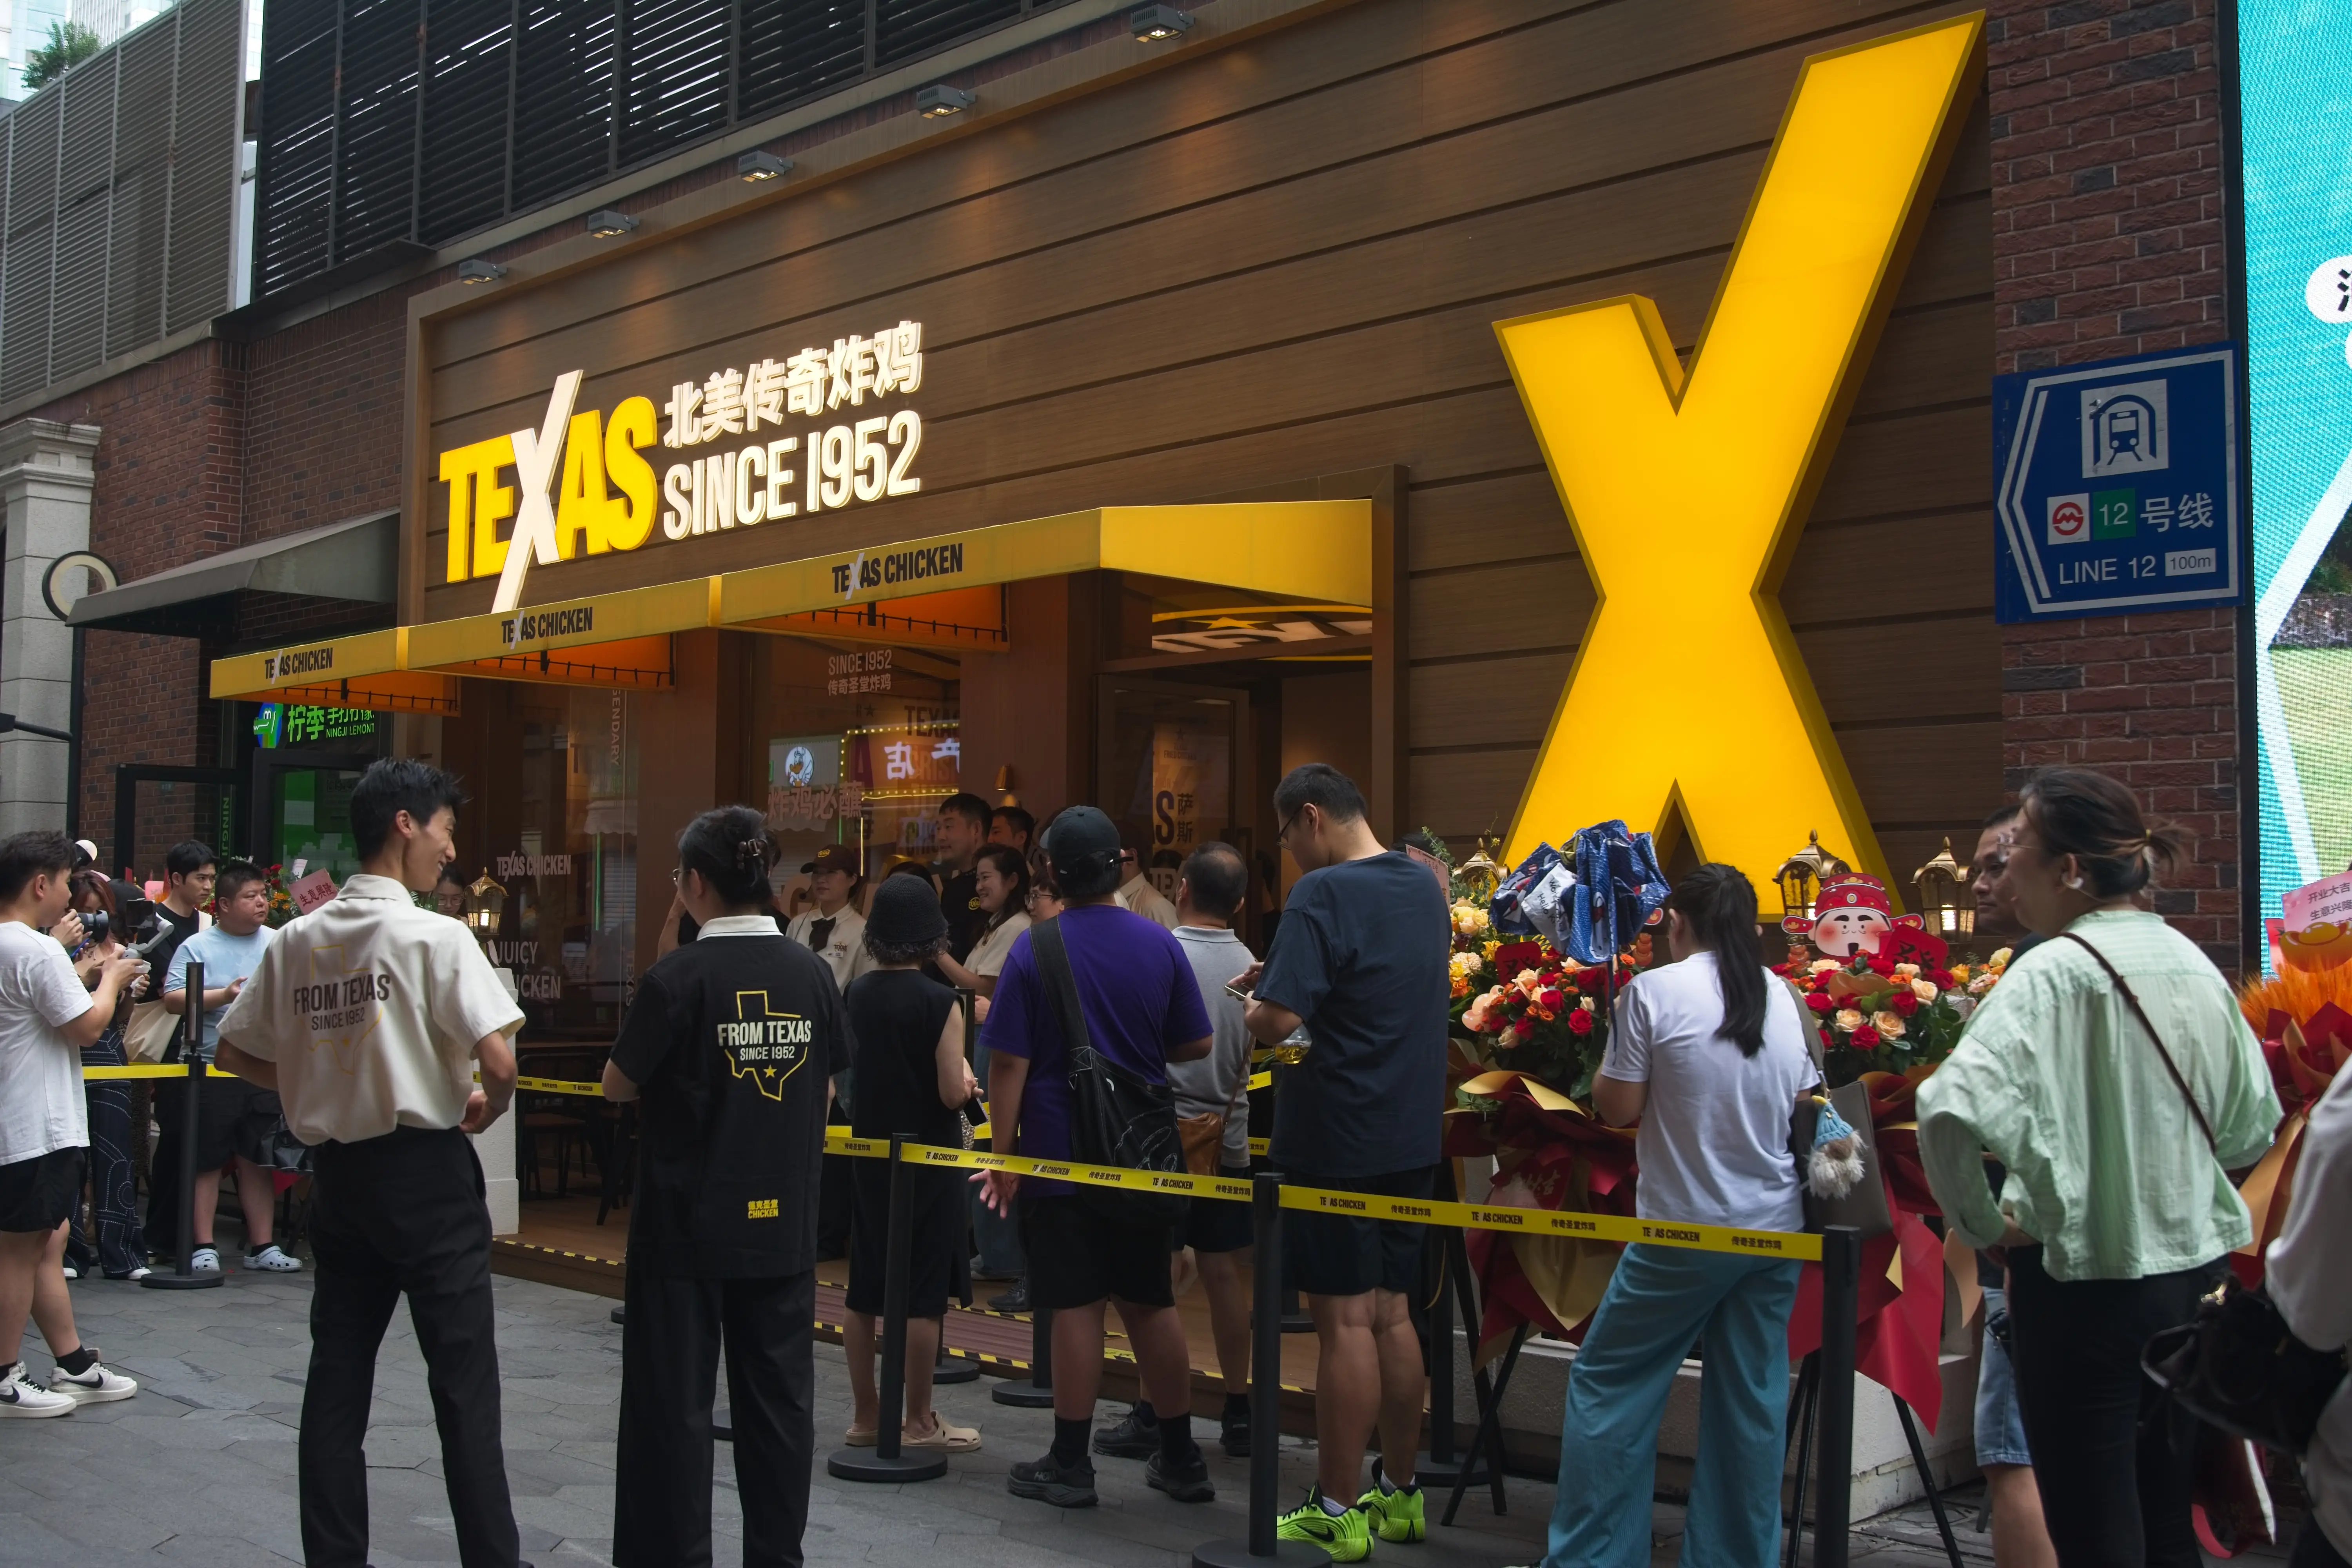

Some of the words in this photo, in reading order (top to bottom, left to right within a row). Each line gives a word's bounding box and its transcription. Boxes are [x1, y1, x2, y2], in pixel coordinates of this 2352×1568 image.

[663, 320, 923, 448] 北美传奇炸鸡
[663, 436, 798, 541] SINCE
[806, 410, 922, 512] 1952
[1491, 9, 1987, 921] X
[439, 369, 658, 614] TEXAS
[2099, 503, 2129, 526] 12
[2140, 492, 2214, 532] 号线
[831, 552, 881, 600] TEXAS
[884, 543, 964, 583] CHICKEN
[2059, 558, 2117, 584] LINE
[2128, 555, 2156, 579] 12
[2169, 554, 2212, 571] 100m
[501, 610, 536, 650] TEXAS
[538, 606, 593, 637] CHICKEN
[265, 650, 291, 684] TEXAS
[292, 648, 333, 674] CHICKEN
[828, 653, 862, 675] SINCE
[866, 649, 892, 671] 1952
[828, 673, 891, 696] 传奇圣堂炸鸡
[288, 704, 324, 742] 柠季
[326, 726, 347, 738] NINGJI
[497, 850, 525, 882] TEXAS
[526, 855, 571, 876] CHICKEN
[299, 882, 334, 907] 生意興隆
[2308, 882, 2351, 904] 开业大吉
[2310, 899, 2352, 921] 生意兴隆
[497, 941, 538, 965] JUICY
[294, 982, 338, 1015] FROM
[343, 974, 390, 1007] TEXAS
[513, 975, 561, 999] ICKEN
[312, 1013, 343, 1031] SINCE
[345, 1007, 365, 1026] 1952
[717, 1022, 763, 1047] FROM
[766, 1020, 811, 1044] TEXAS
[740, 1046, 769, 1061] SINCE
[771, 1046, 795, 1059] 1952
[844, 1142, 870, 1152] 传奇圣堂炸鸡
[938, 1153, 959, 1161] CHICKEN
[975, 1157, 1005, 1166] 传奇圣堂炸鸡
[1046, 1166, 1070, 1176] CHICKEN
[1089, 1171, 1122, 1181] 传奇圣堂炸鸡
[1169, 1179, 1193, 1189] CHICKEN
[1215, 1184, 1250, 1196] 传奇圣堂炸鸡
[748, 1207, 779, 1220] CHICKEN
[1338, 1199, 1366, 1210] CHICKEN
[1391, 1204, 1431, 1217] 传奇圣堂炸鸡
[1492, 1213, 1523, 1225] CHICKEN
[1552, 1218, 1596, 1231] 传奇圣堂炸鸡
[1666, 1228, 1700, 1242] CHICKEN
[1731, 1236, 1782, 1250] 传奇圣堂炸鸡
